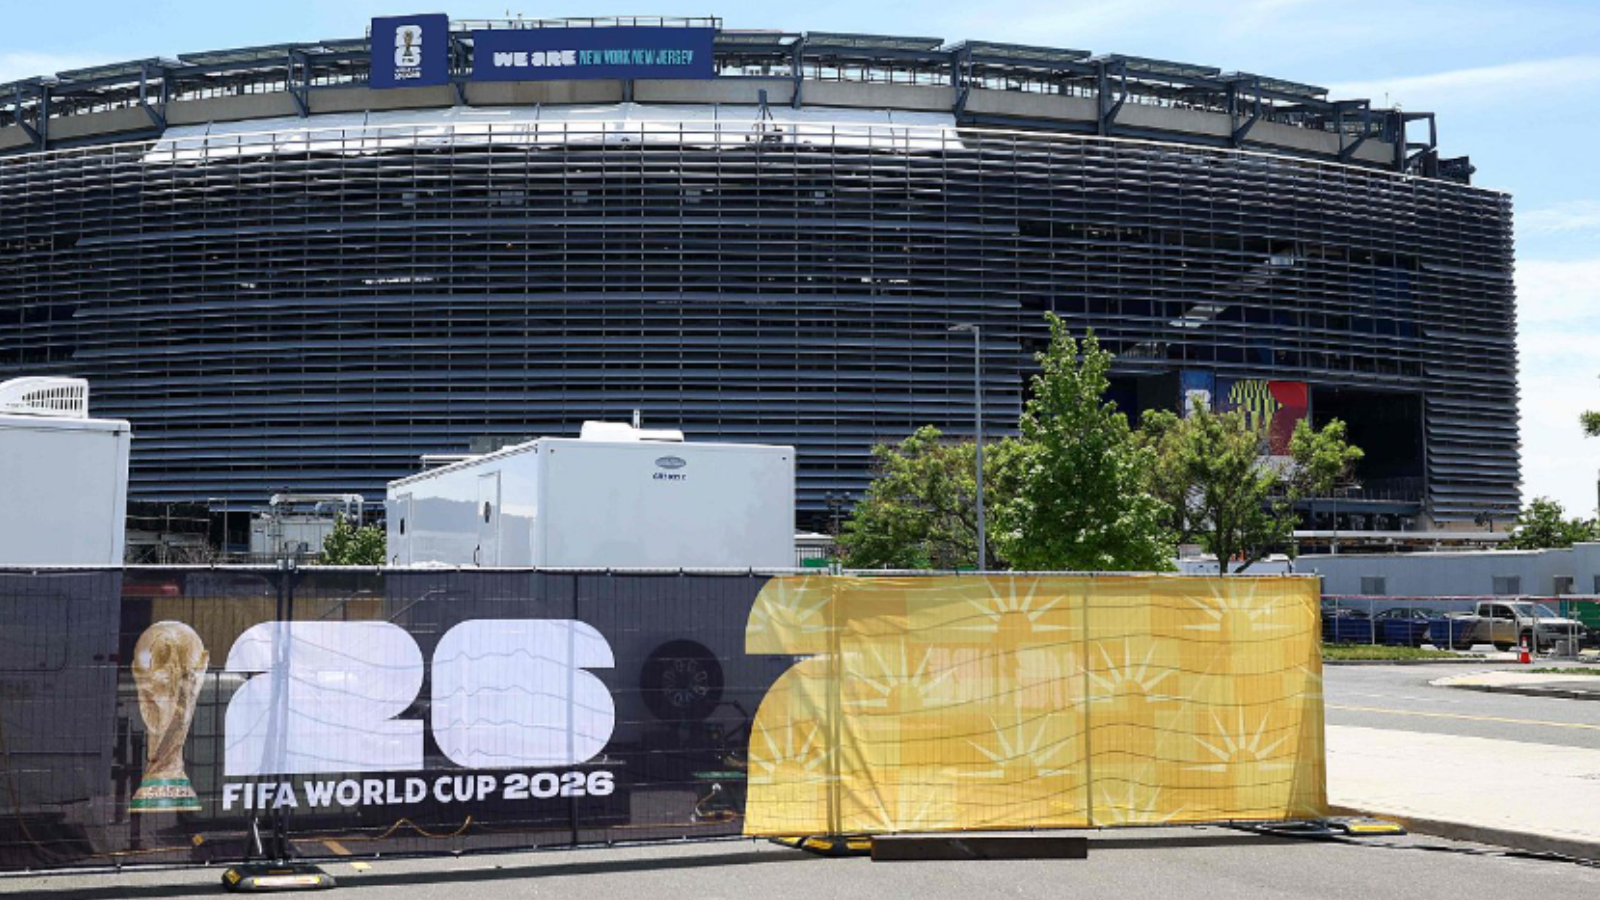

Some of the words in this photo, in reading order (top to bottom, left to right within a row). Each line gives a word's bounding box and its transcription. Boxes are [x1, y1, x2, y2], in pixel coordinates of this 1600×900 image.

[493, 52, 528, 67] WE
[579, 50, 602, 65] NEW
[604, 49, 630, 65] YORK
[631, 49, 656, 65] NEW
[656, 49, 694, 65] JERSEY
[222, 782, 299, 811] FIFA
[303, 778, 427, 807] WORLD
[433, 775, 497, 803] CUP
[502, 771, 615, 800] 2026
